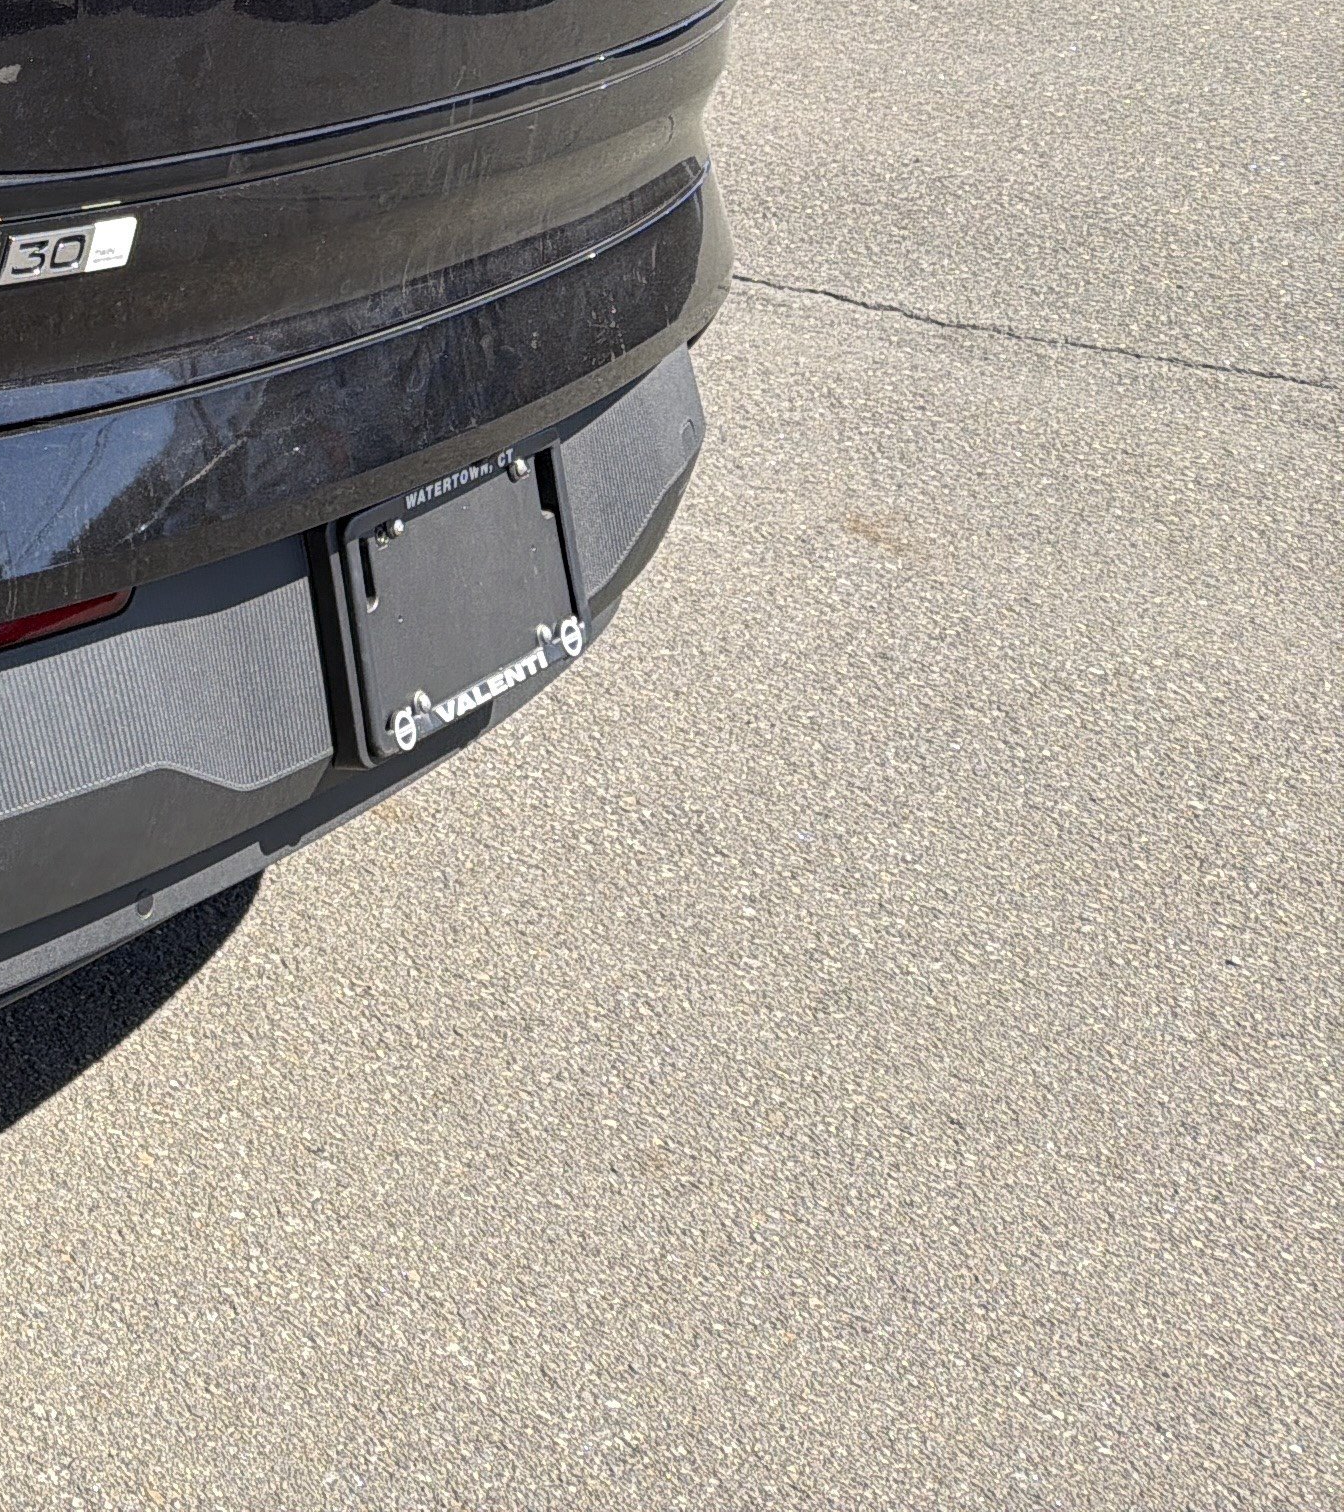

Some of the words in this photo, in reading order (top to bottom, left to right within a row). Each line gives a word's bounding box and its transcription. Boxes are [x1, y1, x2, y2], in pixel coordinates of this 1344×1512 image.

[405, 462, 493, 510] WATERTOWN,
[497, 448, 514, 468] CT
[434, 650, 549, 723] VALENTI
